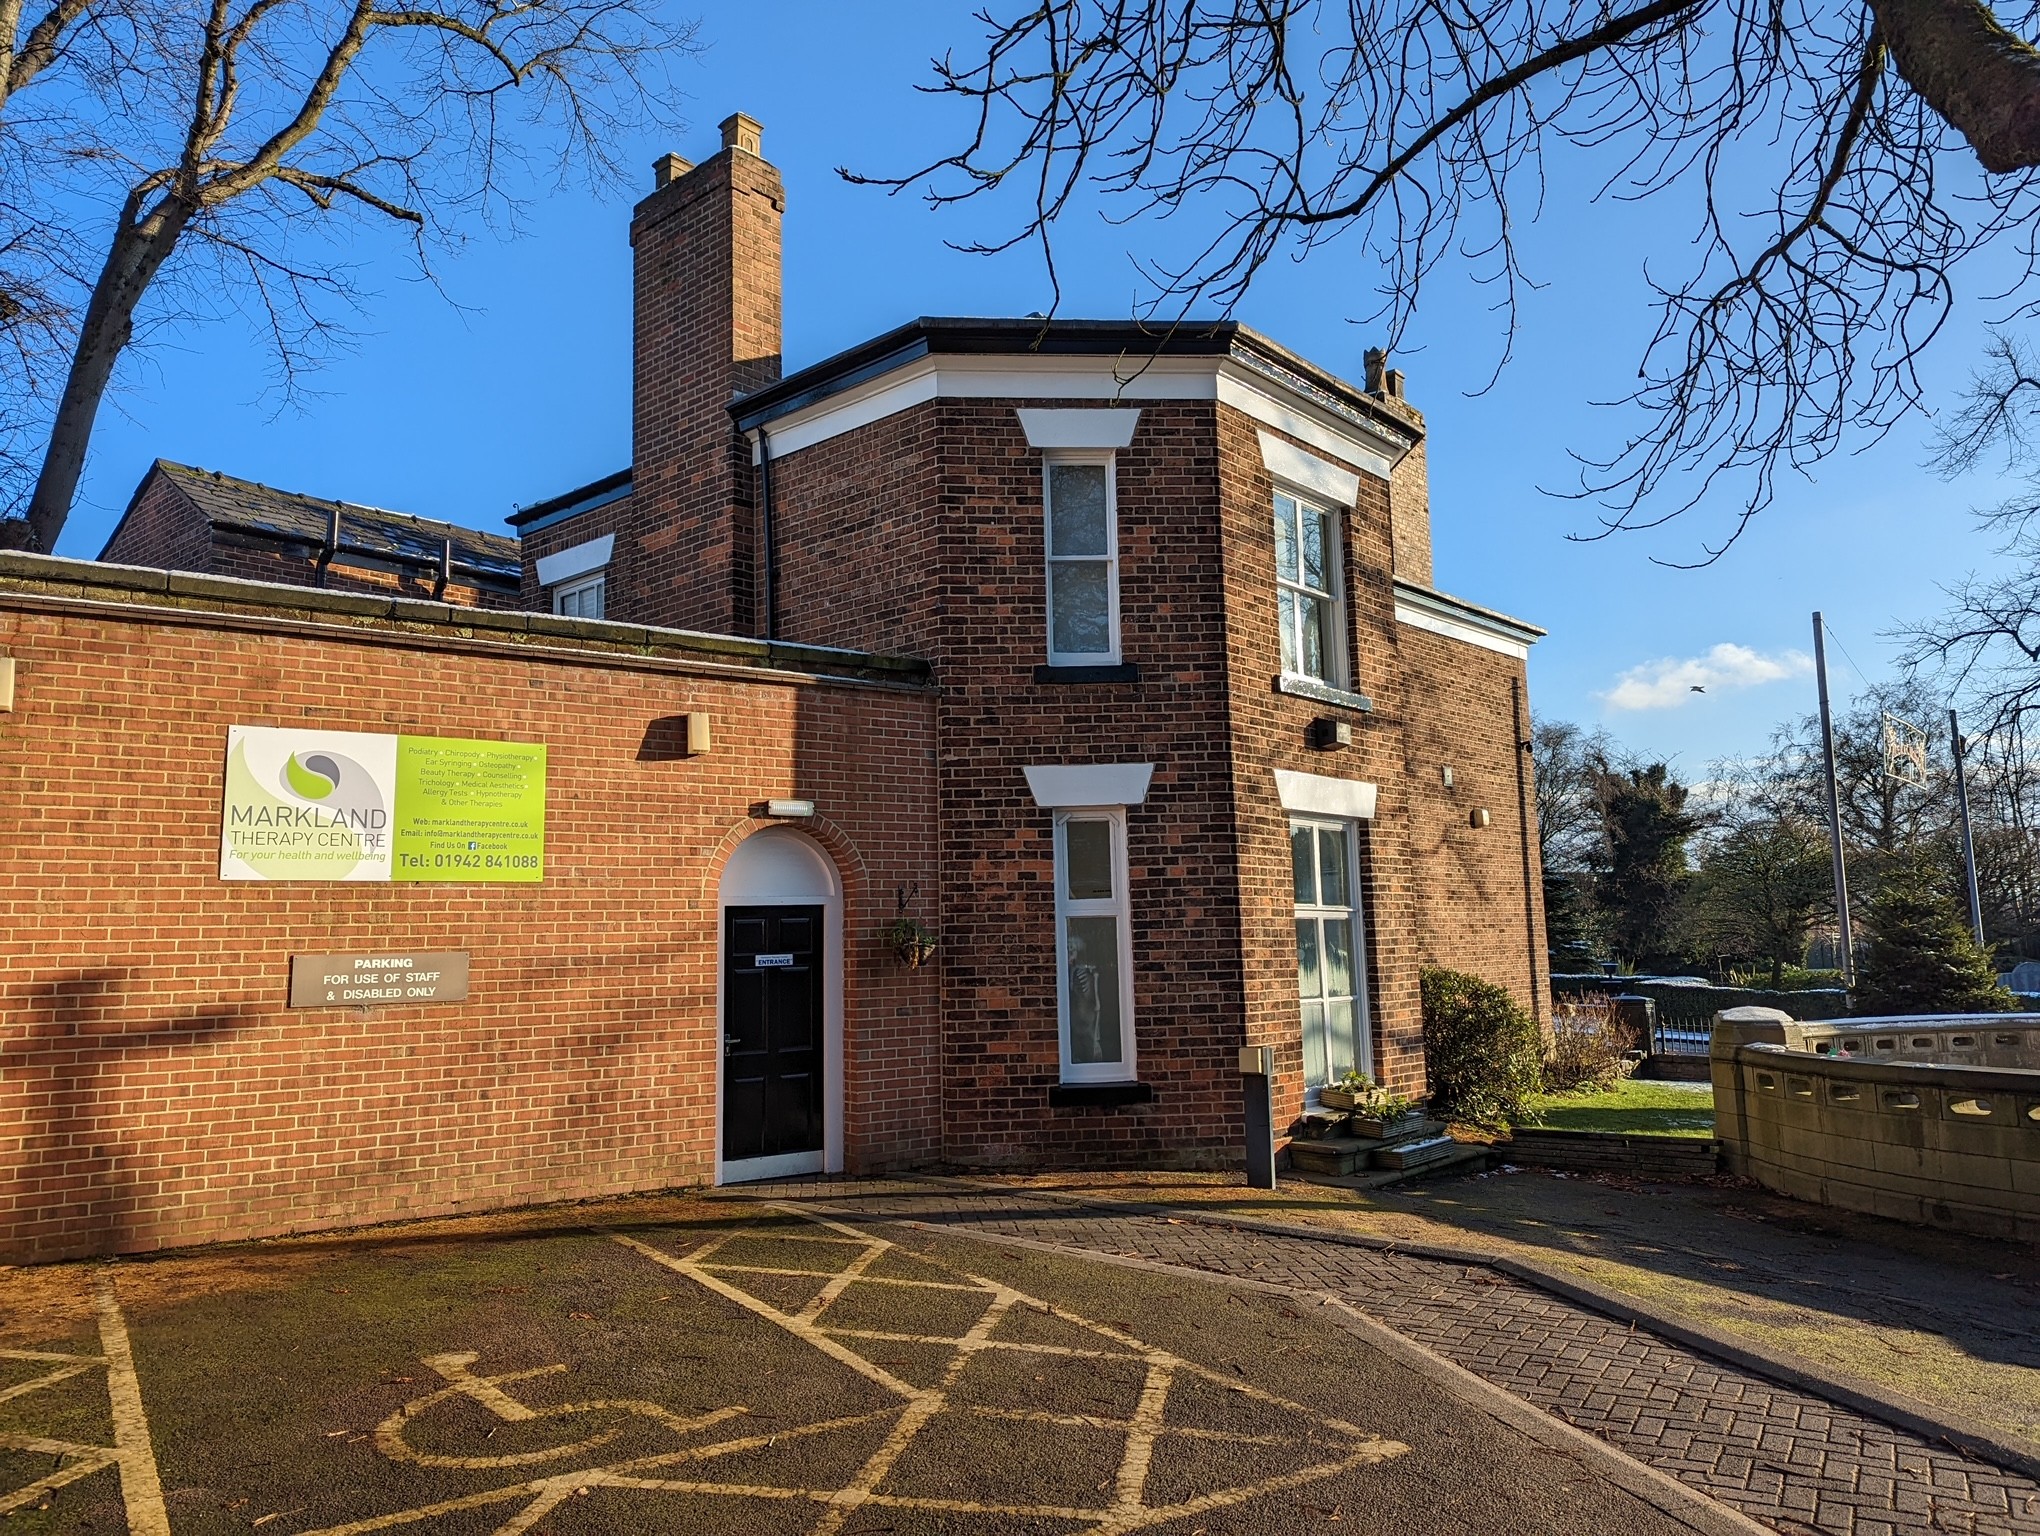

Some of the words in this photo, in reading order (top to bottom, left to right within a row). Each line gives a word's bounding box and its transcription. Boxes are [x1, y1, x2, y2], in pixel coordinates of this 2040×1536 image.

[409, 747, 438, 756] Podiatry
[445, 750, 481, 758] Chiropody
[486, 752, 534, 762] Physiotherapy
[439, 759, 472, 768] Syringing
[479, 761, 516, 770] Osteopathy
[447, 770, 475, 778] Therapy
[483, 771, 521, 780] Counselling
[418, 779, 454, 787] Trichology
[423, 789, 448, 797] Allergy
[476, 790, 522, 799] Hypnotherapy
[470, 800, 502, 808] Therapies
[231, 805, 386, 829] MARKLAND
[432, 818, 528, 828] marklandtherapycentre.co.uk
[231, 830, 313, 846] THERAPY
[318, 832, 386, 847] CENTRE
[401, 829, 422, 837] Email:
[424, 830, 538, 839] info@marklandtherapycentre.co.uk
[229, 850, 249, 859] For
[250, 851, 275, 861] your
[279, 851, 311, 860] health
[314, 851, 335, 860] and
[337, 851, 386, 862] wellbeing
[400, 853, 430, 867] Tel:
[435, 854, 481, 868] 01942
[485, 855, 538, 868] 841088
[354, 958, 413, 969] PARKING
[323, 974, 349, 985] FOR
[354, 974, 378, 984] USE
[384, 973, 400, 983] OF
[405, 972, 440, 983] STAFF
[327, 992, 335, 1001] &
[343, 988, 402, 1000] DISABLED
[407, 987, 436, 998] ONLY
